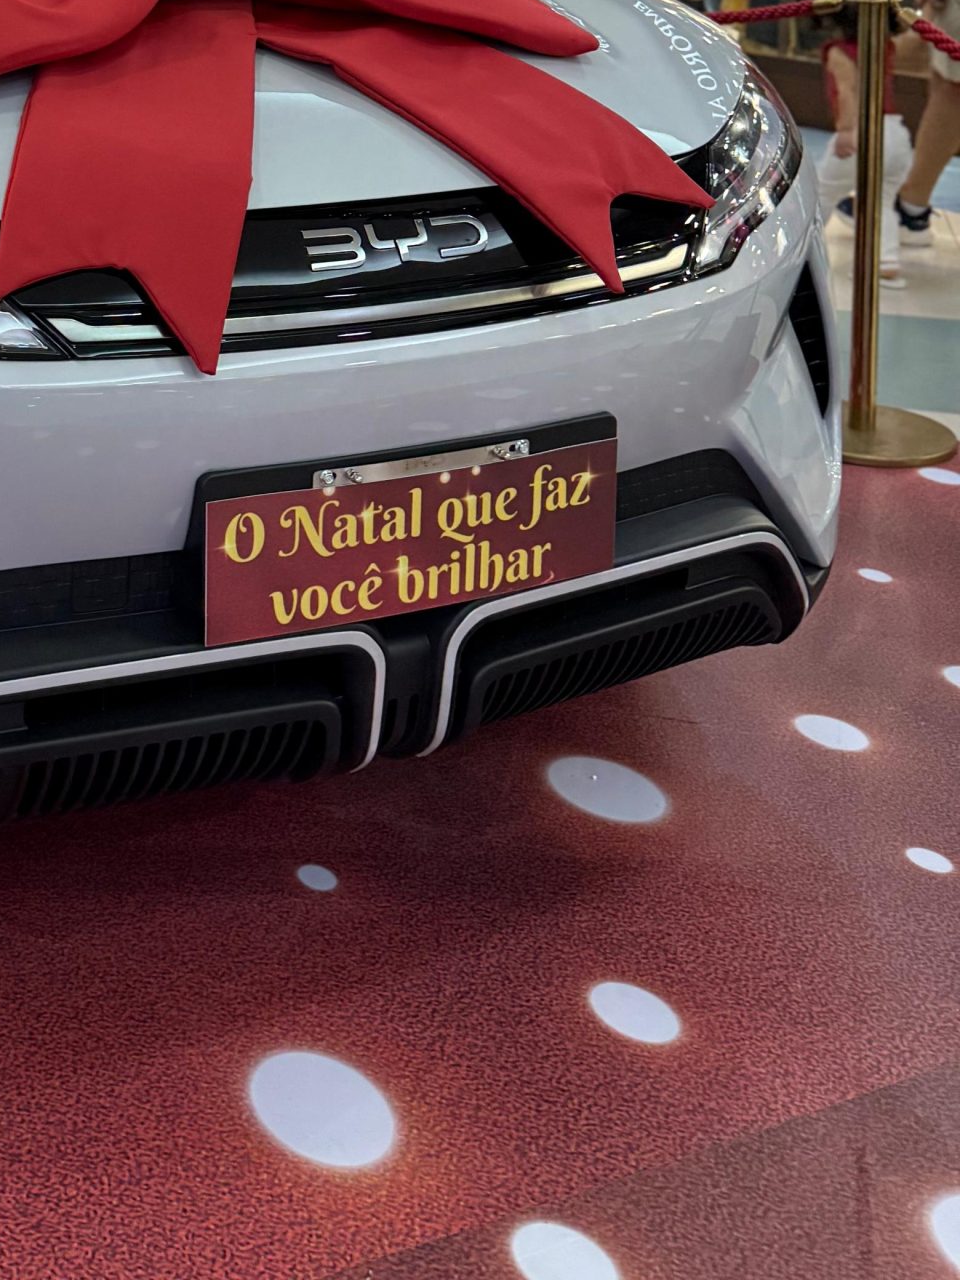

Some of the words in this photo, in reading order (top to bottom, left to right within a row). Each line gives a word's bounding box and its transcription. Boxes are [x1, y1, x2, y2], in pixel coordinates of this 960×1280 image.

[300, 213, 489, 272] BYD
[224, 511, 266, 563] O
[278, 487, 422, 558] Natal
[437, 484, 518, 544] que
[519, 464, 591, 531] faz
[269, 564, 385, 626] você
[396, 540, 553, 605] brilhar
